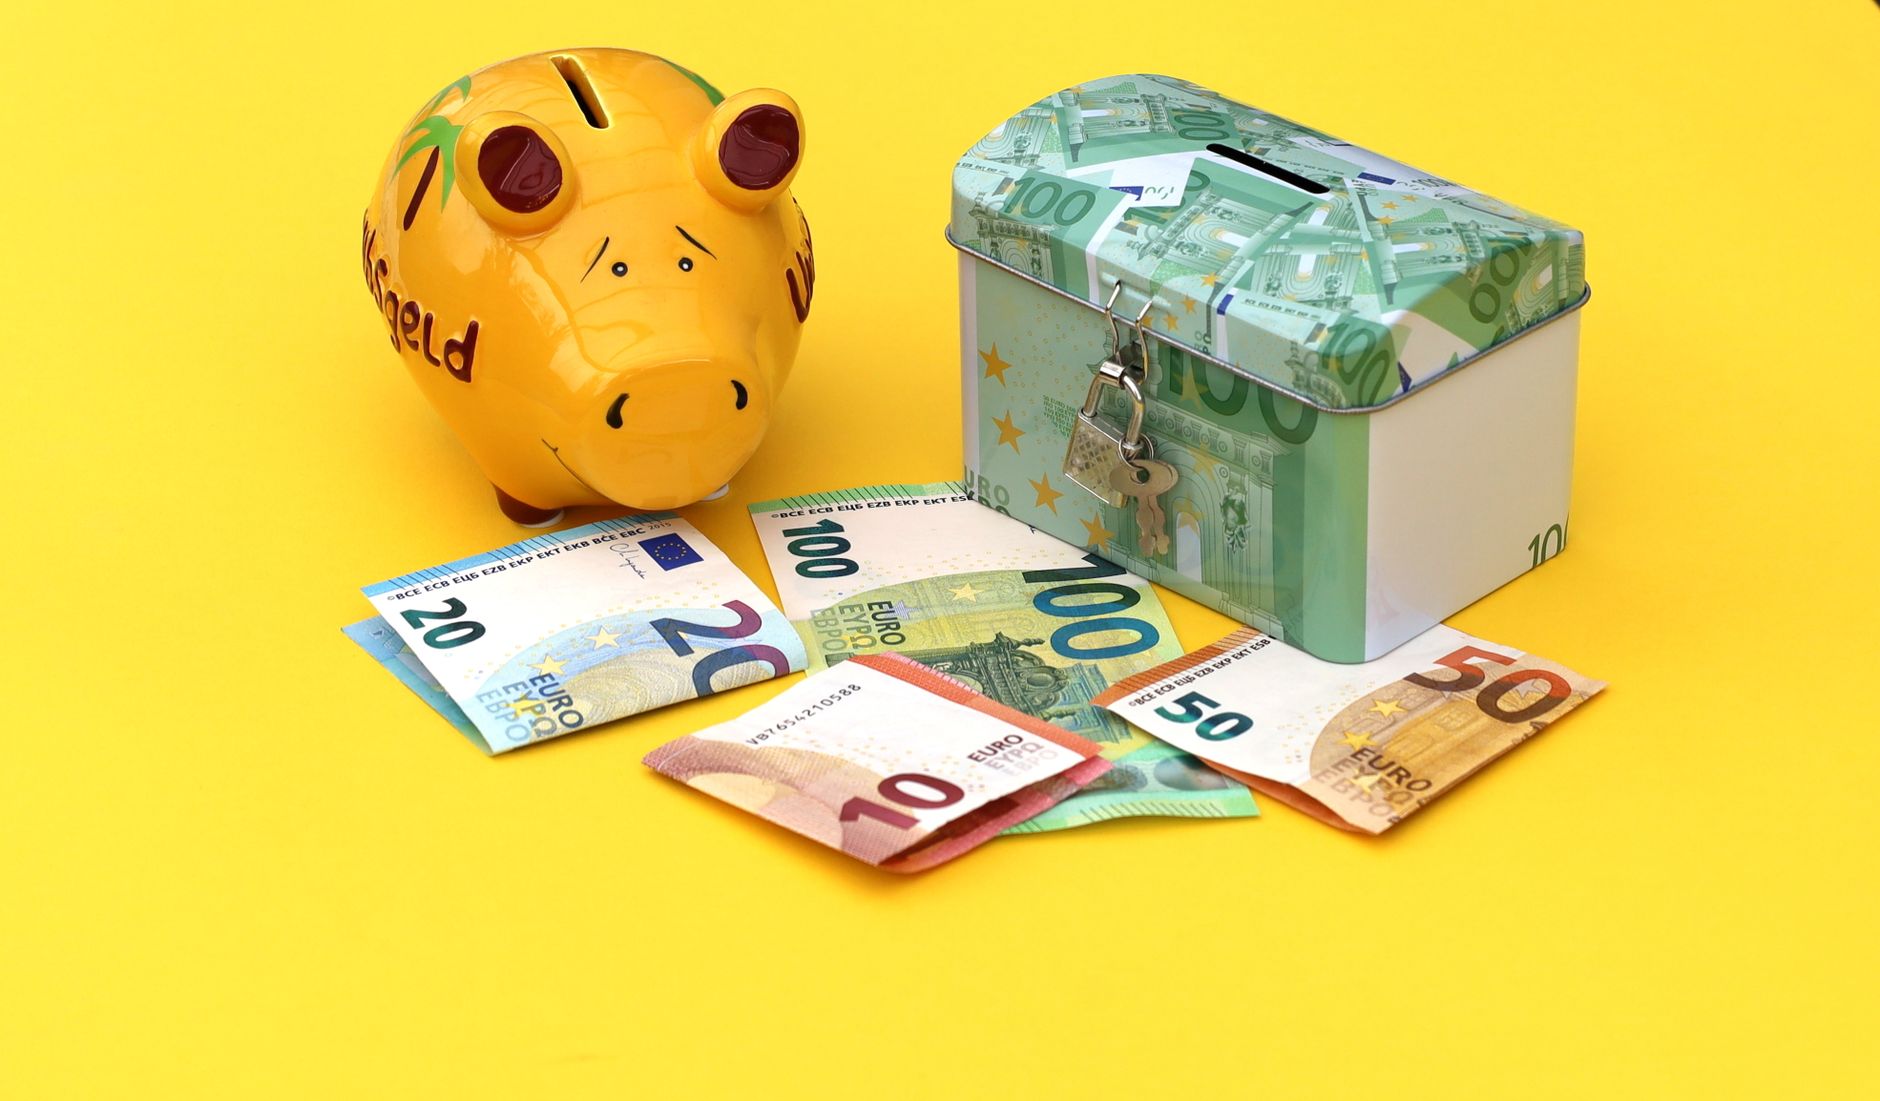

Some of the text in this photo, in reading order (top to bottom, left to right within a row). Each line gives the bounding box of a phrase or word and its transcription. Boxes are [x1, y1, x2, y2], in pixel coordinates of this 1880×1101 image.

[1004, 176, 1097, 226] 100
[1322, 322, 1391, 407] 100
[809, 507, 834, 515] ECB
[867, 501, 892, 509] EZB
[895, 497, 919, 506] EKP
[923, 497, 947, 506] EKT
[424, 580, 450, 593] ECB
[481, 564, 507, 576] EZB
[508, 556, 534, 569] EKP
[536, 545, 560, 560] EKT
[564, 541, 590, 552] EKB
[620, 528, 646, 539] EBC
[648, 522, 672, 531] 2015
[782, 518, 860, 579] 100
[1528, 523, 1568, 568] 10
[400, 597, 487, 650] 20
[866, 600, 906, 646] EURO
[1022, 552, 1161, 660] 100
[649, 599, 791, 697] 20
[1154, 683, 1176, 696] ECB
[1194, 667, 1215, 678] EZB
[1212, 658, 1232, 670] EKP
[1231, 648, 1252, 660] EKT
[1250, 639, 1271, 651] ESB
[529, 672, 585, 729] EURO
[1402, 645, 1572, 724] 50
[1153, 690, 1254, 742] 50
[967, 734, 1024, 763] EURO
[1349, 745, 1433, 793] EURO
[839, 772, 965, 831] 10
